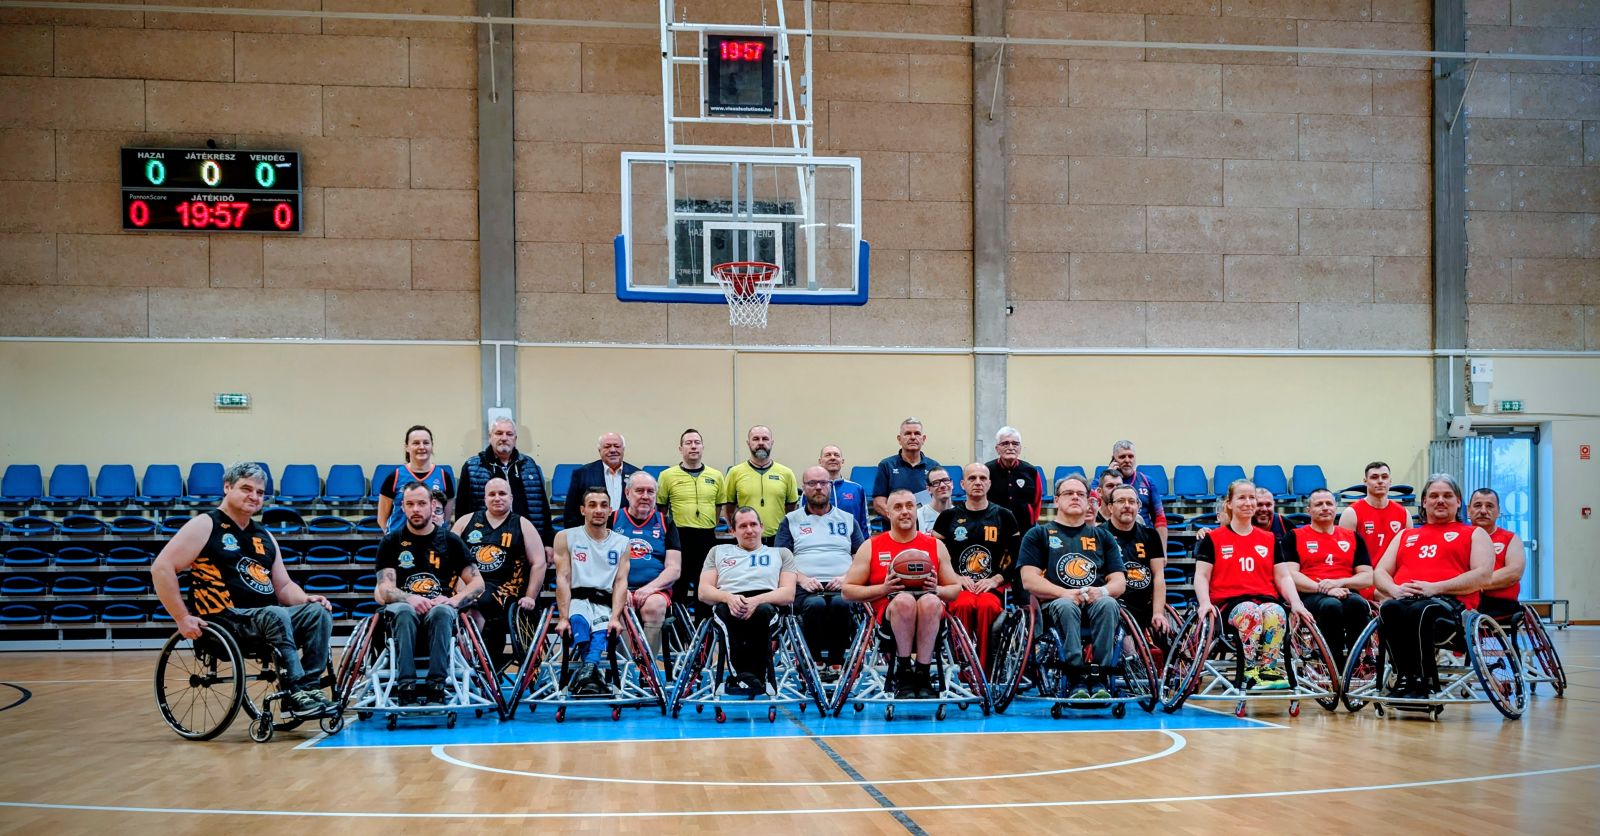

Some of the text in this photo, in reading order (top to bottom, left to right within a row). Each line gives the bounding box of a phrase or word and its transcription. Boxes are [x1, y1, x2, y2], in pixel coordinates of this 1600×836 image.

[721, 41, 765, 60] 19:57
[185, 152, 236, 161] JÁTÉKRÉSZ
[250, 154, 286, 162] VENDÉG
[146, 160, 166, 185] 0
[201, 160, 221, 187] 0
[255, 161, 275, 188] 0
[129, 199, 149, 227] 0
[175, 201, 249, 229] 19:57
[273, 202, 293, 231] 0
[1138, 487, 1149, 496] 12
[652, 530, 661, 539] 5
[828, 521, 848, 536] 18
[984, 526, 998, 542] 10
[252, 536, 265, 555] 6
[501, 532, 513, 548] 11
[1080, 536, 1097, 551] 15
[1377, 533, 1385, 547] 7
[608, 550, 618, 566] 9
[1135, 542, 1146, 558] 5
[1418, 544, 1438, 558] 33
[429, 550, 440, 569] 4
[750, 554, 770, 567] 10
[1238, 556, 1255, 572] 10
[1324, 553, 1334, 566] 4
